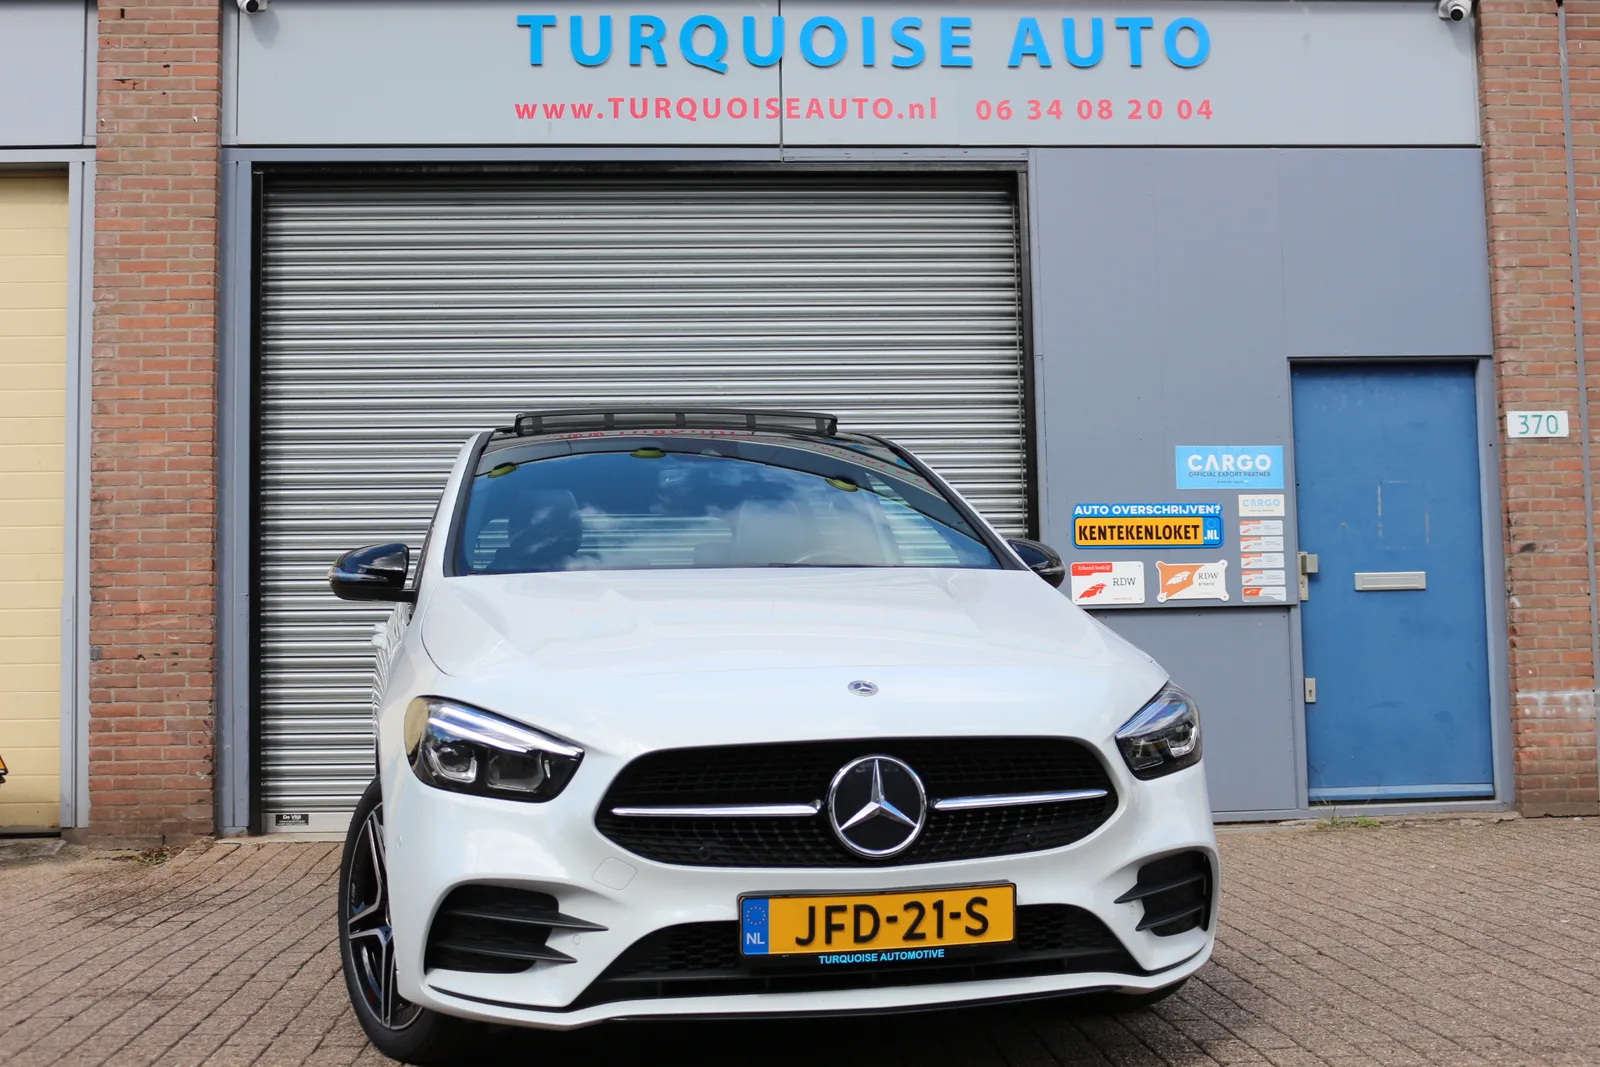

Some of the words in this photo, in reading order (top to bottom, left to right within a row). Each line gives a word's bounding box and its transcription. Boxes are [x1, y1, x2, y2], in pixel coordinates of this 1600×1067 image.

[516, 14, 973, 75] TURQUOISE
[1007, 16, 1211, 68] AUTO
[514, 97, 937, 121] www.TURQUOISEAUTO.nl
[975, 99, 1013, 120] 06
[1026, 99, 1063, 120] 34
[1076, 99, 1113, 120] 08
[1127, 99, 1163, 120] 20
[1176, 99, 1213, 120] 04
[1518, 414, 1559, 435] 370
[1187, 454, 1272, 471] CARGO
[1074, 505, 1109, 515] AUTO
[1112, 505, 1221, 515] OVERSCHRIJVEN?
[1242, 499, 1281, 508] CARGO
[1078, 525, 1200, 541] KENTEKENLOKET
[1203, 530, 1220, 540] .NL
[1112, 577, 1136, 586] RDW
[1198, 572, 1219, 580] RDW
[795, 896, 990, 947] JFD-21-S
[746, 932, 765, 945] NL
[818, 953, 878, 965] TURQUOISE
[879, 949, 945, 962] AUTOMOTIVE
